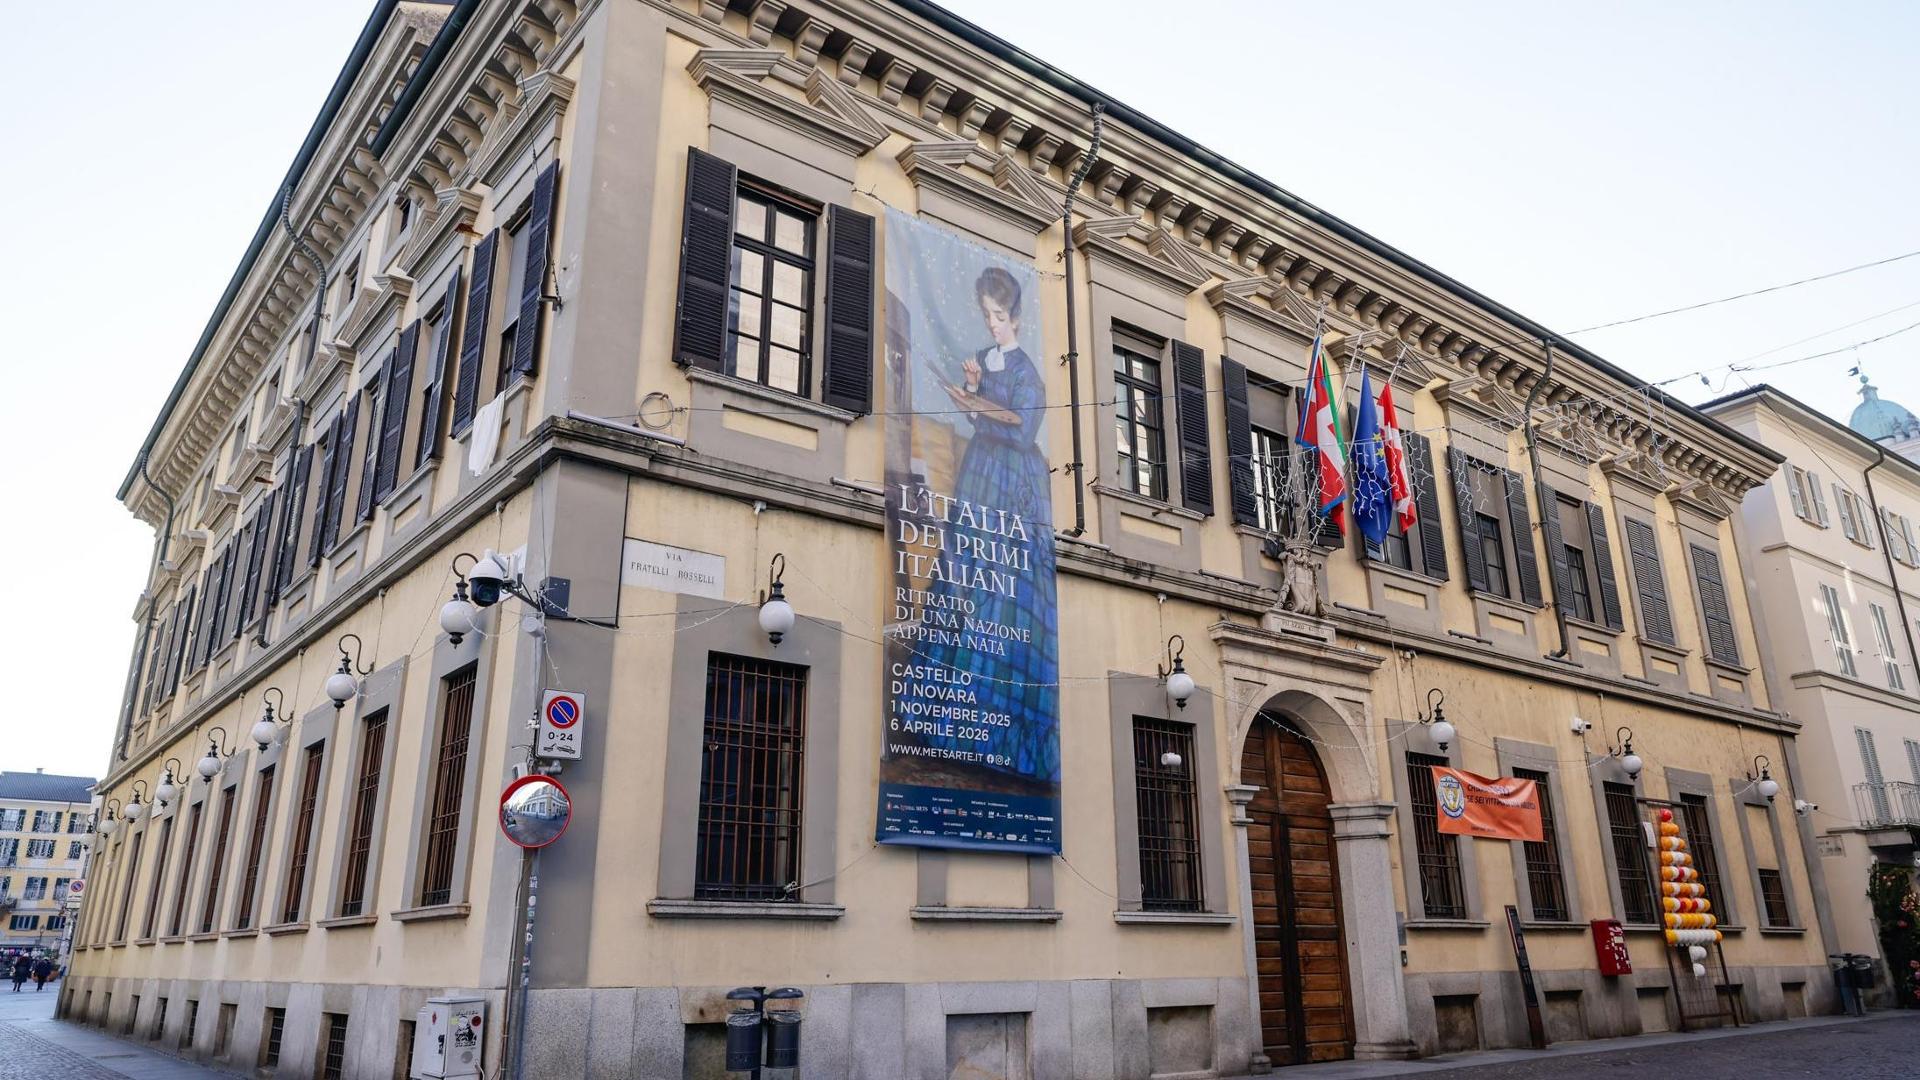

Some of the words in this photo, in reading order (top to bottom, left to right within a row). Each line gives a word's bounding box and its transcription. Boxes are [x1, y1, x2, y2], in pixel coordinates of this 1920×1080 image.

[899, 483, 1030, 542] L'ITALIA
[665, 552, 682, 562] VIA
[897, 519, 946, 551] DEI
[954, 533, 1032, 571] PRIMI
[631, 561, 669, 576] FRATELLI
[678, 570, 715, 584] ROSSELLI
[896, 551, 1017, 598] ITALIANI
[896, 587, 975, 614] RITRATTO
[895, 606, 915, 621] DI
[922, 609, 960, 629] UNA
[963, 616, 1031, 643] NAZIONE
[893, 624, 963, 648] APPENA
[967, 635, 1006, 656] NATA
[892, 663, 972, 686] CASTELLO
[892, 681, 907, 695] DI
[913, 683, 977, 704] NOVARA
[891, 700, 896, 712] 1
[900, 701, 979, 722] NOVEMBRE
[981, 712, 1011, 727] 2025
[890, 719, 899, 731] 6
[903, 720, 954, 737] APRILE
[957, 727, 989, 741] 2026
[890, 743, 984, 762] WWW.METSARTE.IT
